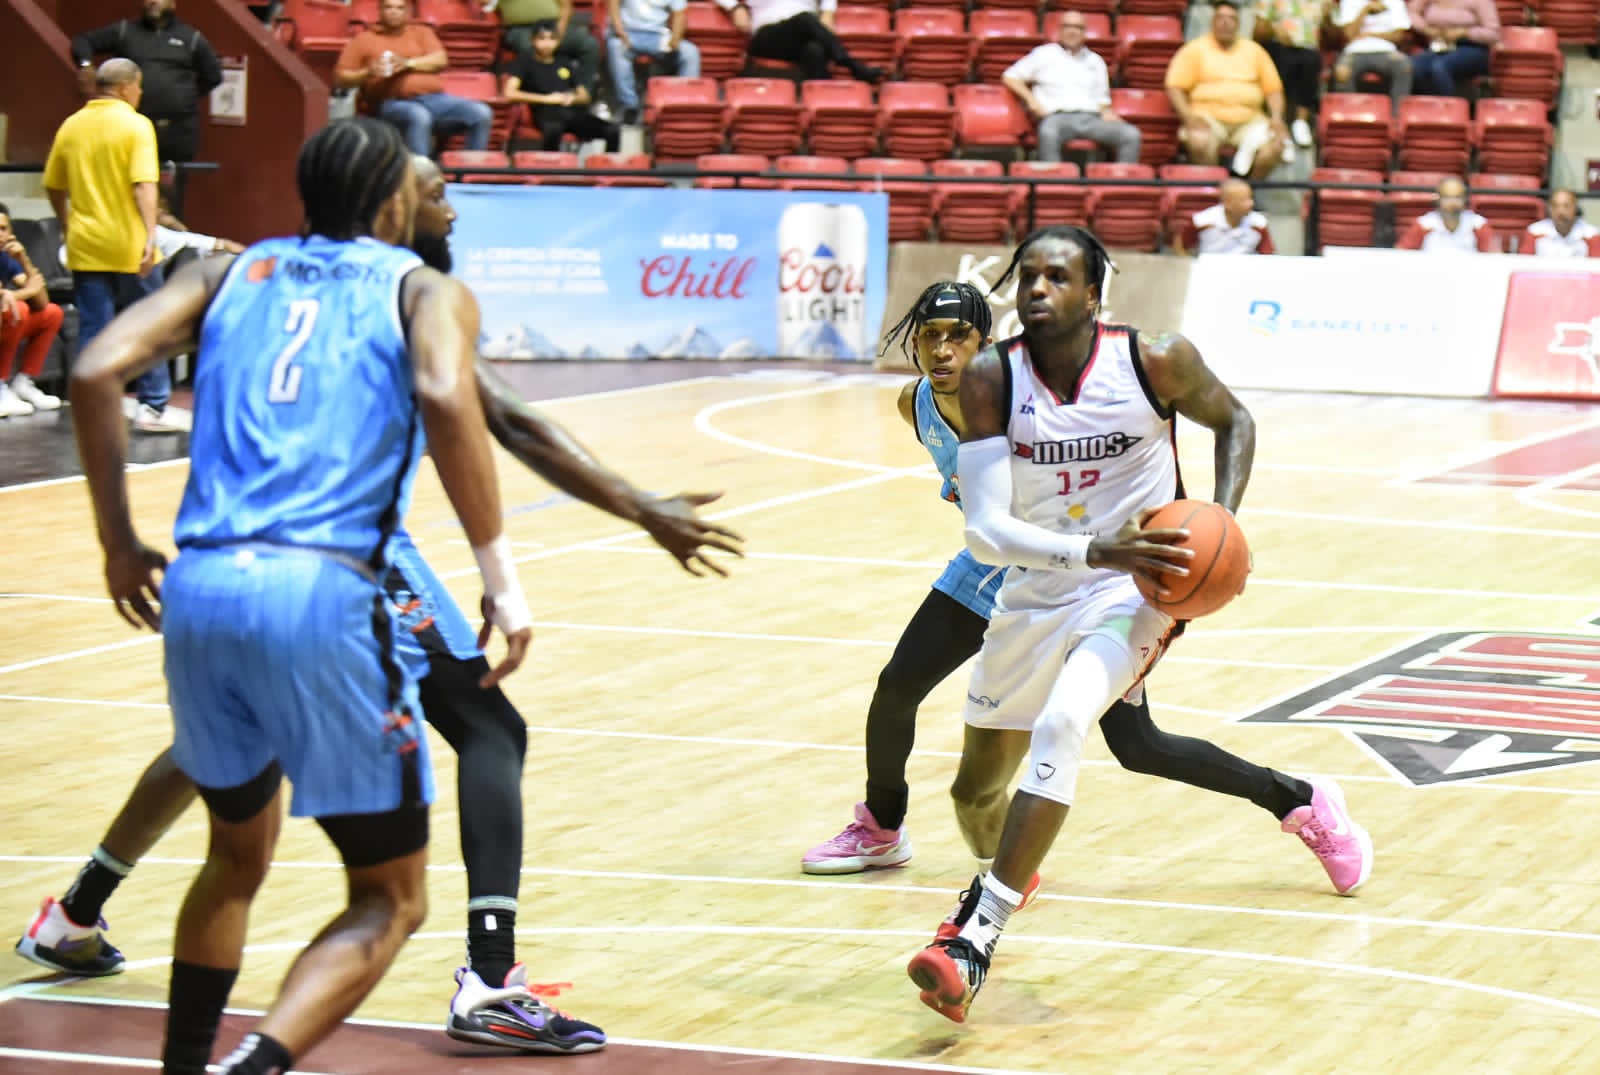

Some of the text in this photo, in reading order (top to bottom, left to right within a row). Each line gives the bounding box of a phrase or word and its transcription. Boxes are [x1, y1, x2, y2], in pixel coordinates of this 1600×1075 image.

[661, 233, 739, 249] MADE TO
[640, 254, 757, 299] Chill
[267, 299, 320, 404] 2
[1031, 431, 1127, 465] INDIOS
[1056, 469, 1102, 496] 12
